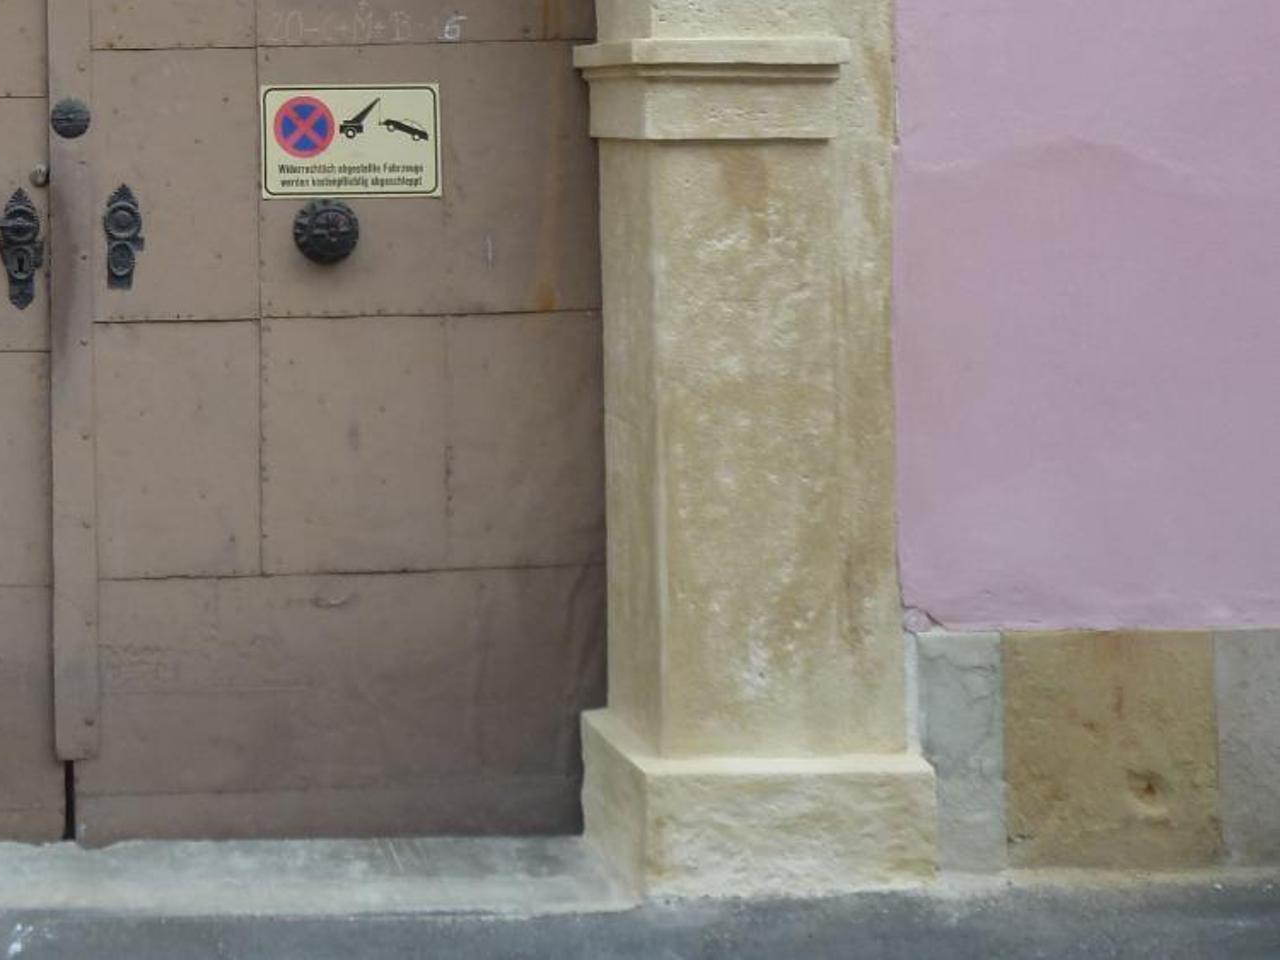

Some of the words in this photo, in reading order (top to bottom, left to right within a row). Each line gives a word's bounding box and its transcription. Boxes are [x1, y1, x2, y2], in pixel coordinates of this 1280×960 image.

[278, 164, 335, 175] Widerrechtlich
[383, 162, 424, 176] Fahrzeuge
[280, 177, 309, 188] werden
